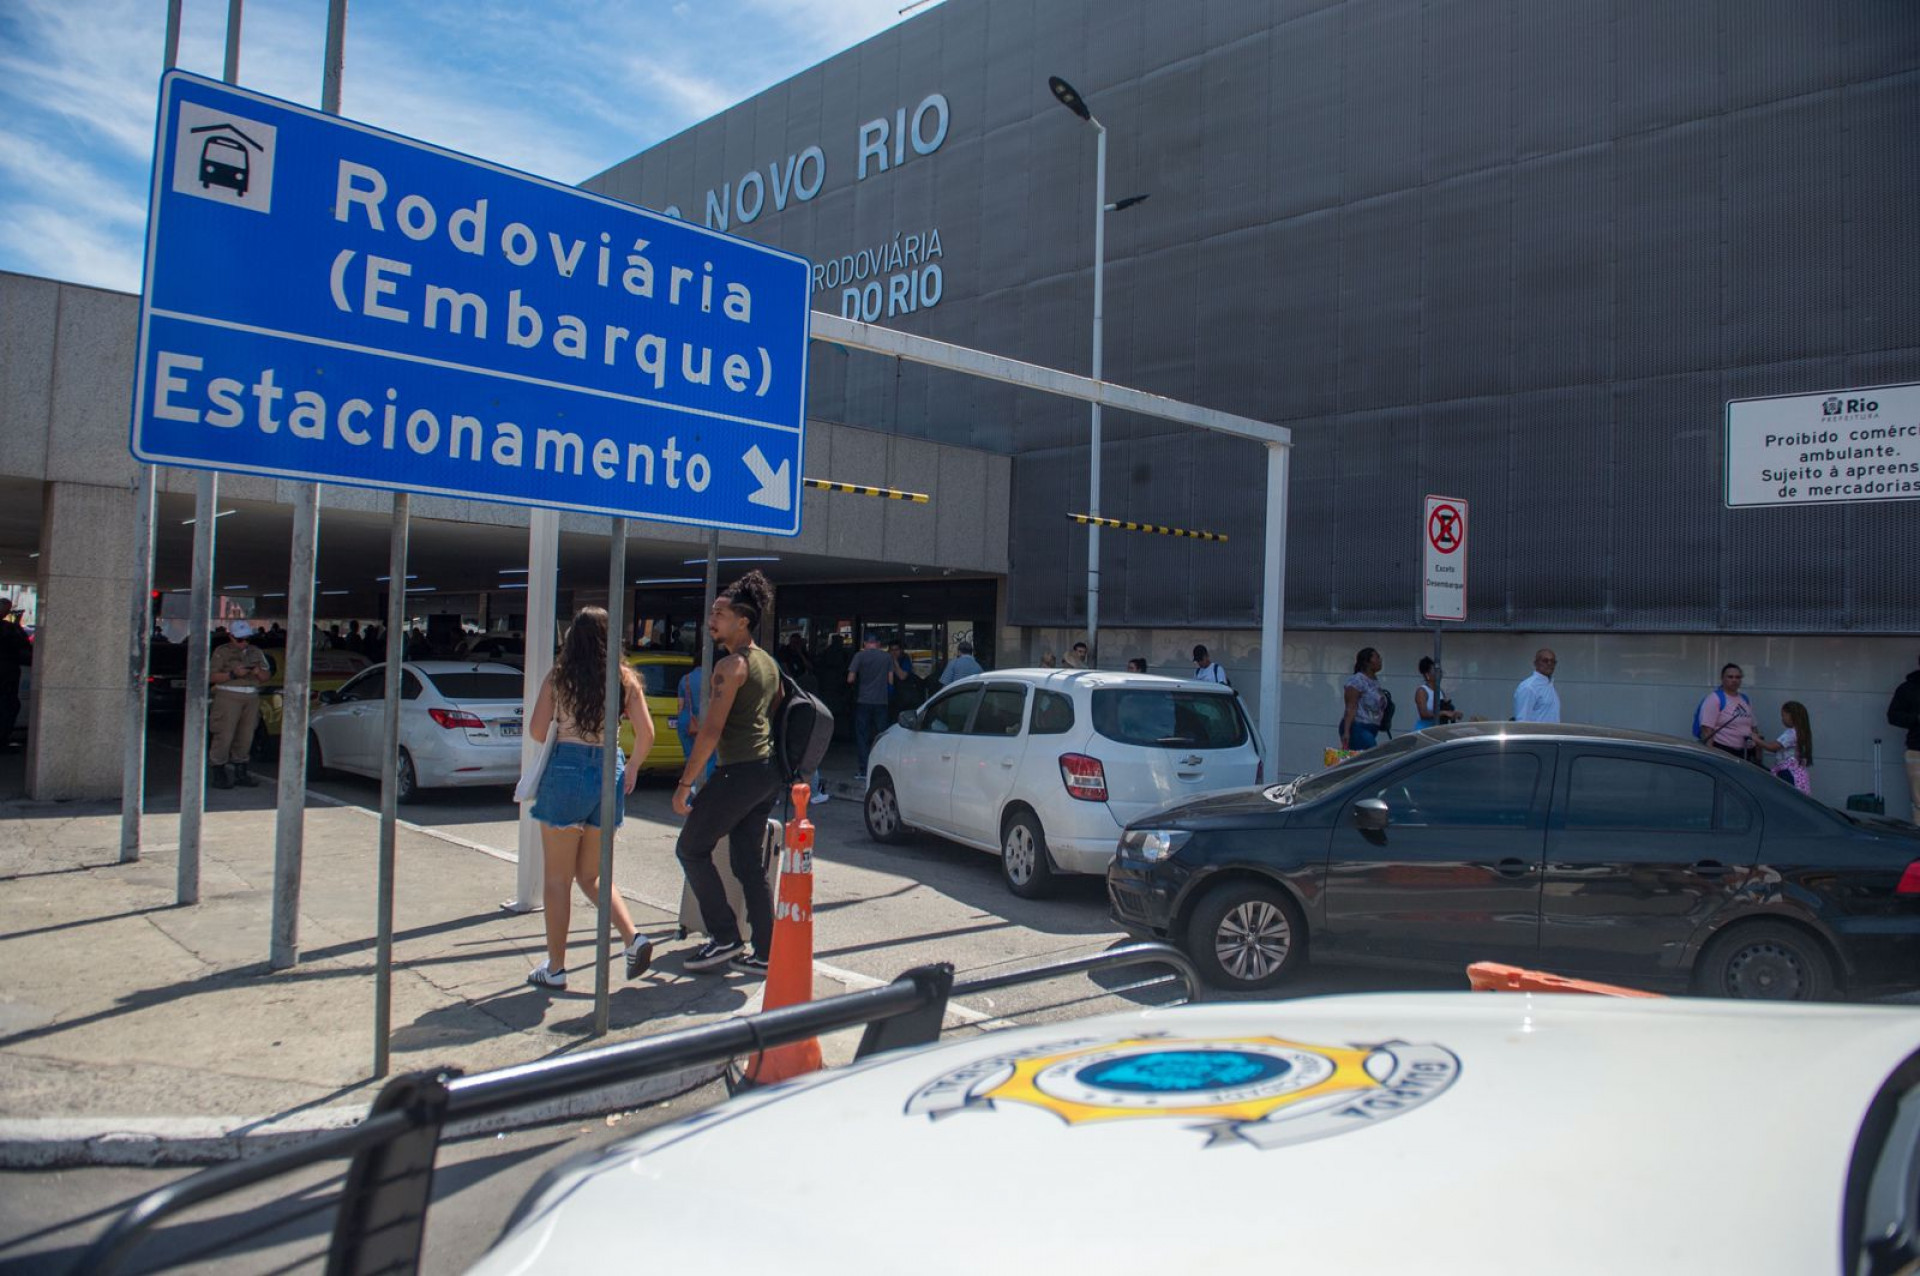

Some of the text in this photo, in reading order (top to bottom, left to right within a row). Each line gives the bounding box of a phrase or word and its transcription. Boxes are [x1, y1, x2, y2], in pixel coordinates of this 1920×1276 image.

[705, 94, 949, 232] NOVO RIO
[334, 158, 753, 324] Rodoviária
[811, 228, 943, 293] RODOVIÁRIA
[841, 264, 943, 322] DO RIO
[330, 249, 773, 397] (Embarque)
[153, 350, 712, 493] Estacionamento
[1821, 413, 1879, 422] PREFEITURA
[1847, 398, 1879, 413] Rio
[1766, 431, 1838, 447] Proibido
[1800, 445, 1900, 463] ambulante.
[1762, 469, 1822, 484] Sujeito
[1778, 485, 1797, 498] de
